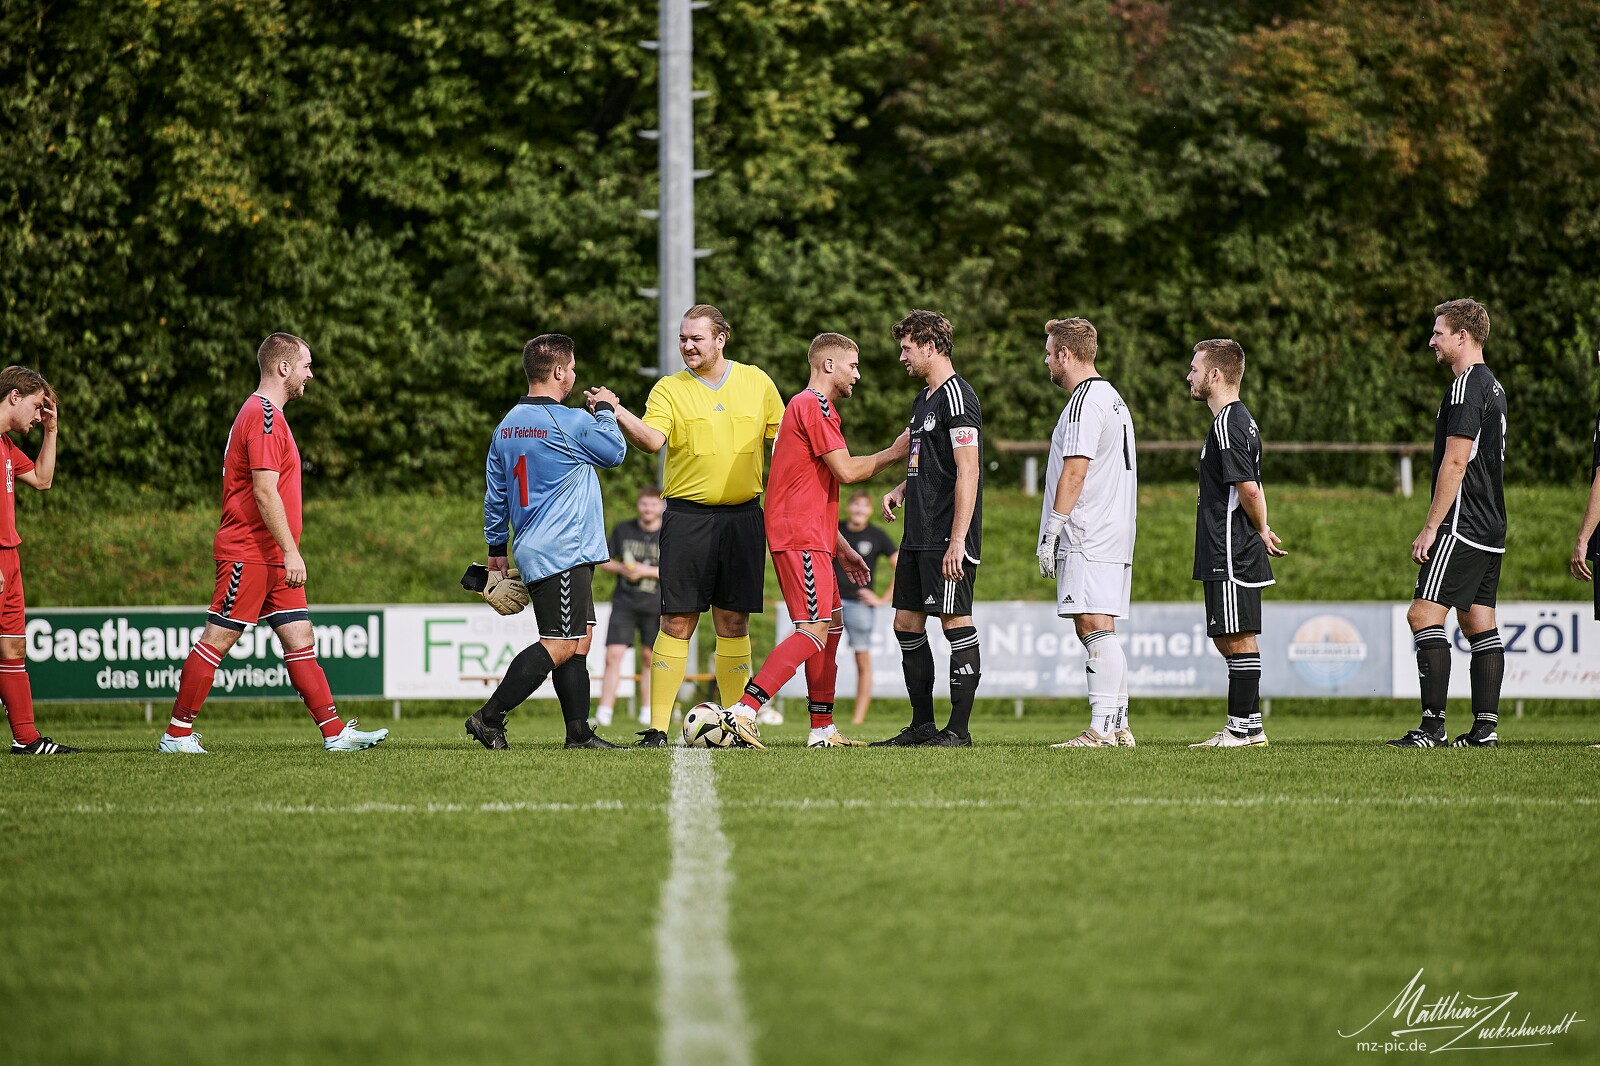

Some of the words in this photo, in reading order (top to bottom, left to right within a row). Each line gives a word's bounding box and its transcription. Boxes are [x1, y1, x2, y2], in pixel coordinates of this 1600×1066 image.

[514, 426, 548, 439] Feichten
[513, 454, 529, 507] 1
[97, 666, 139, 689] das
